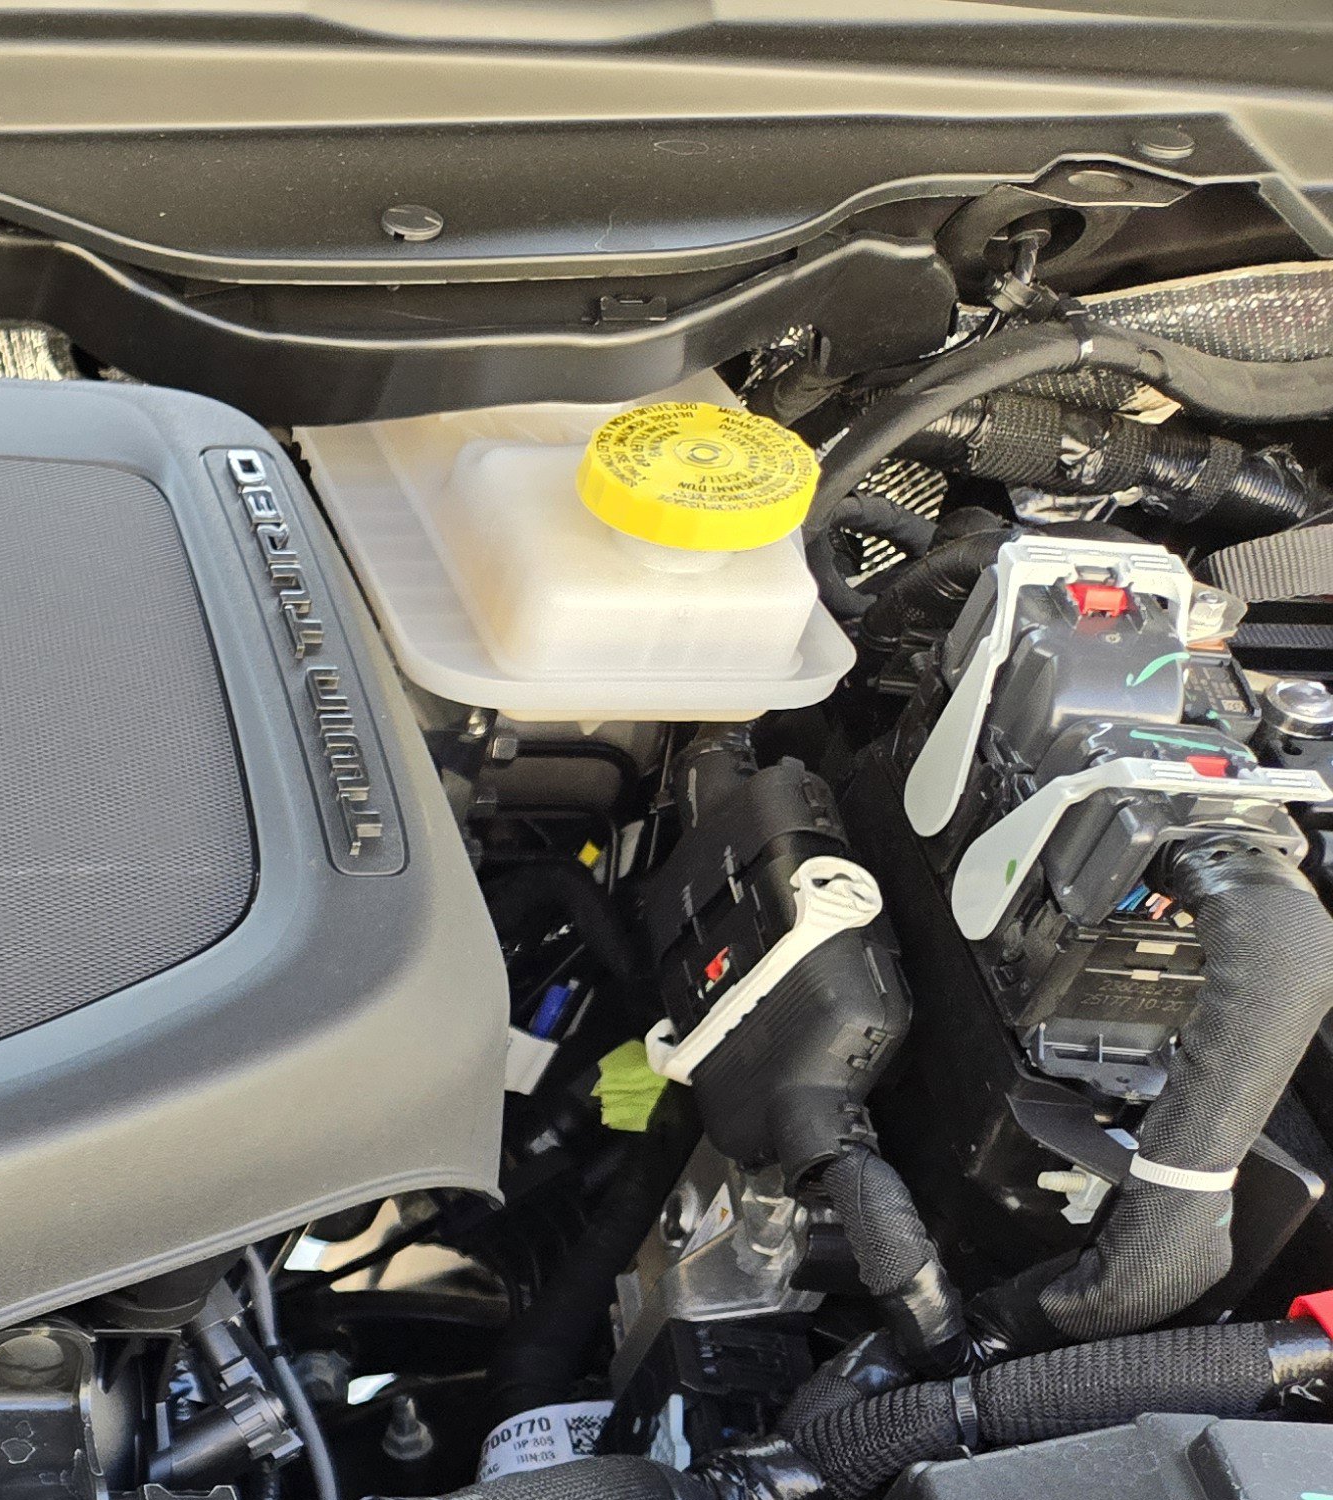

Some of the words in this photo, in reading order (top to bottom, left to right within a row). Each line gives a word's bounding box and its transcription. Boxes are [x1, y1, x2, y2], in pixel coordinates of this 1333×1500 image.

[609, 413, 635, 427] FROM
[721, 416, 760, 431] AVANT
[630, 431, 651, 452] FILLER
[614, 451, 630, 464] USE
[632, 454, 651, 468] CAP
[226, 449, 325, 660] TURBO
[305, 667, 383, 857] TWIN
